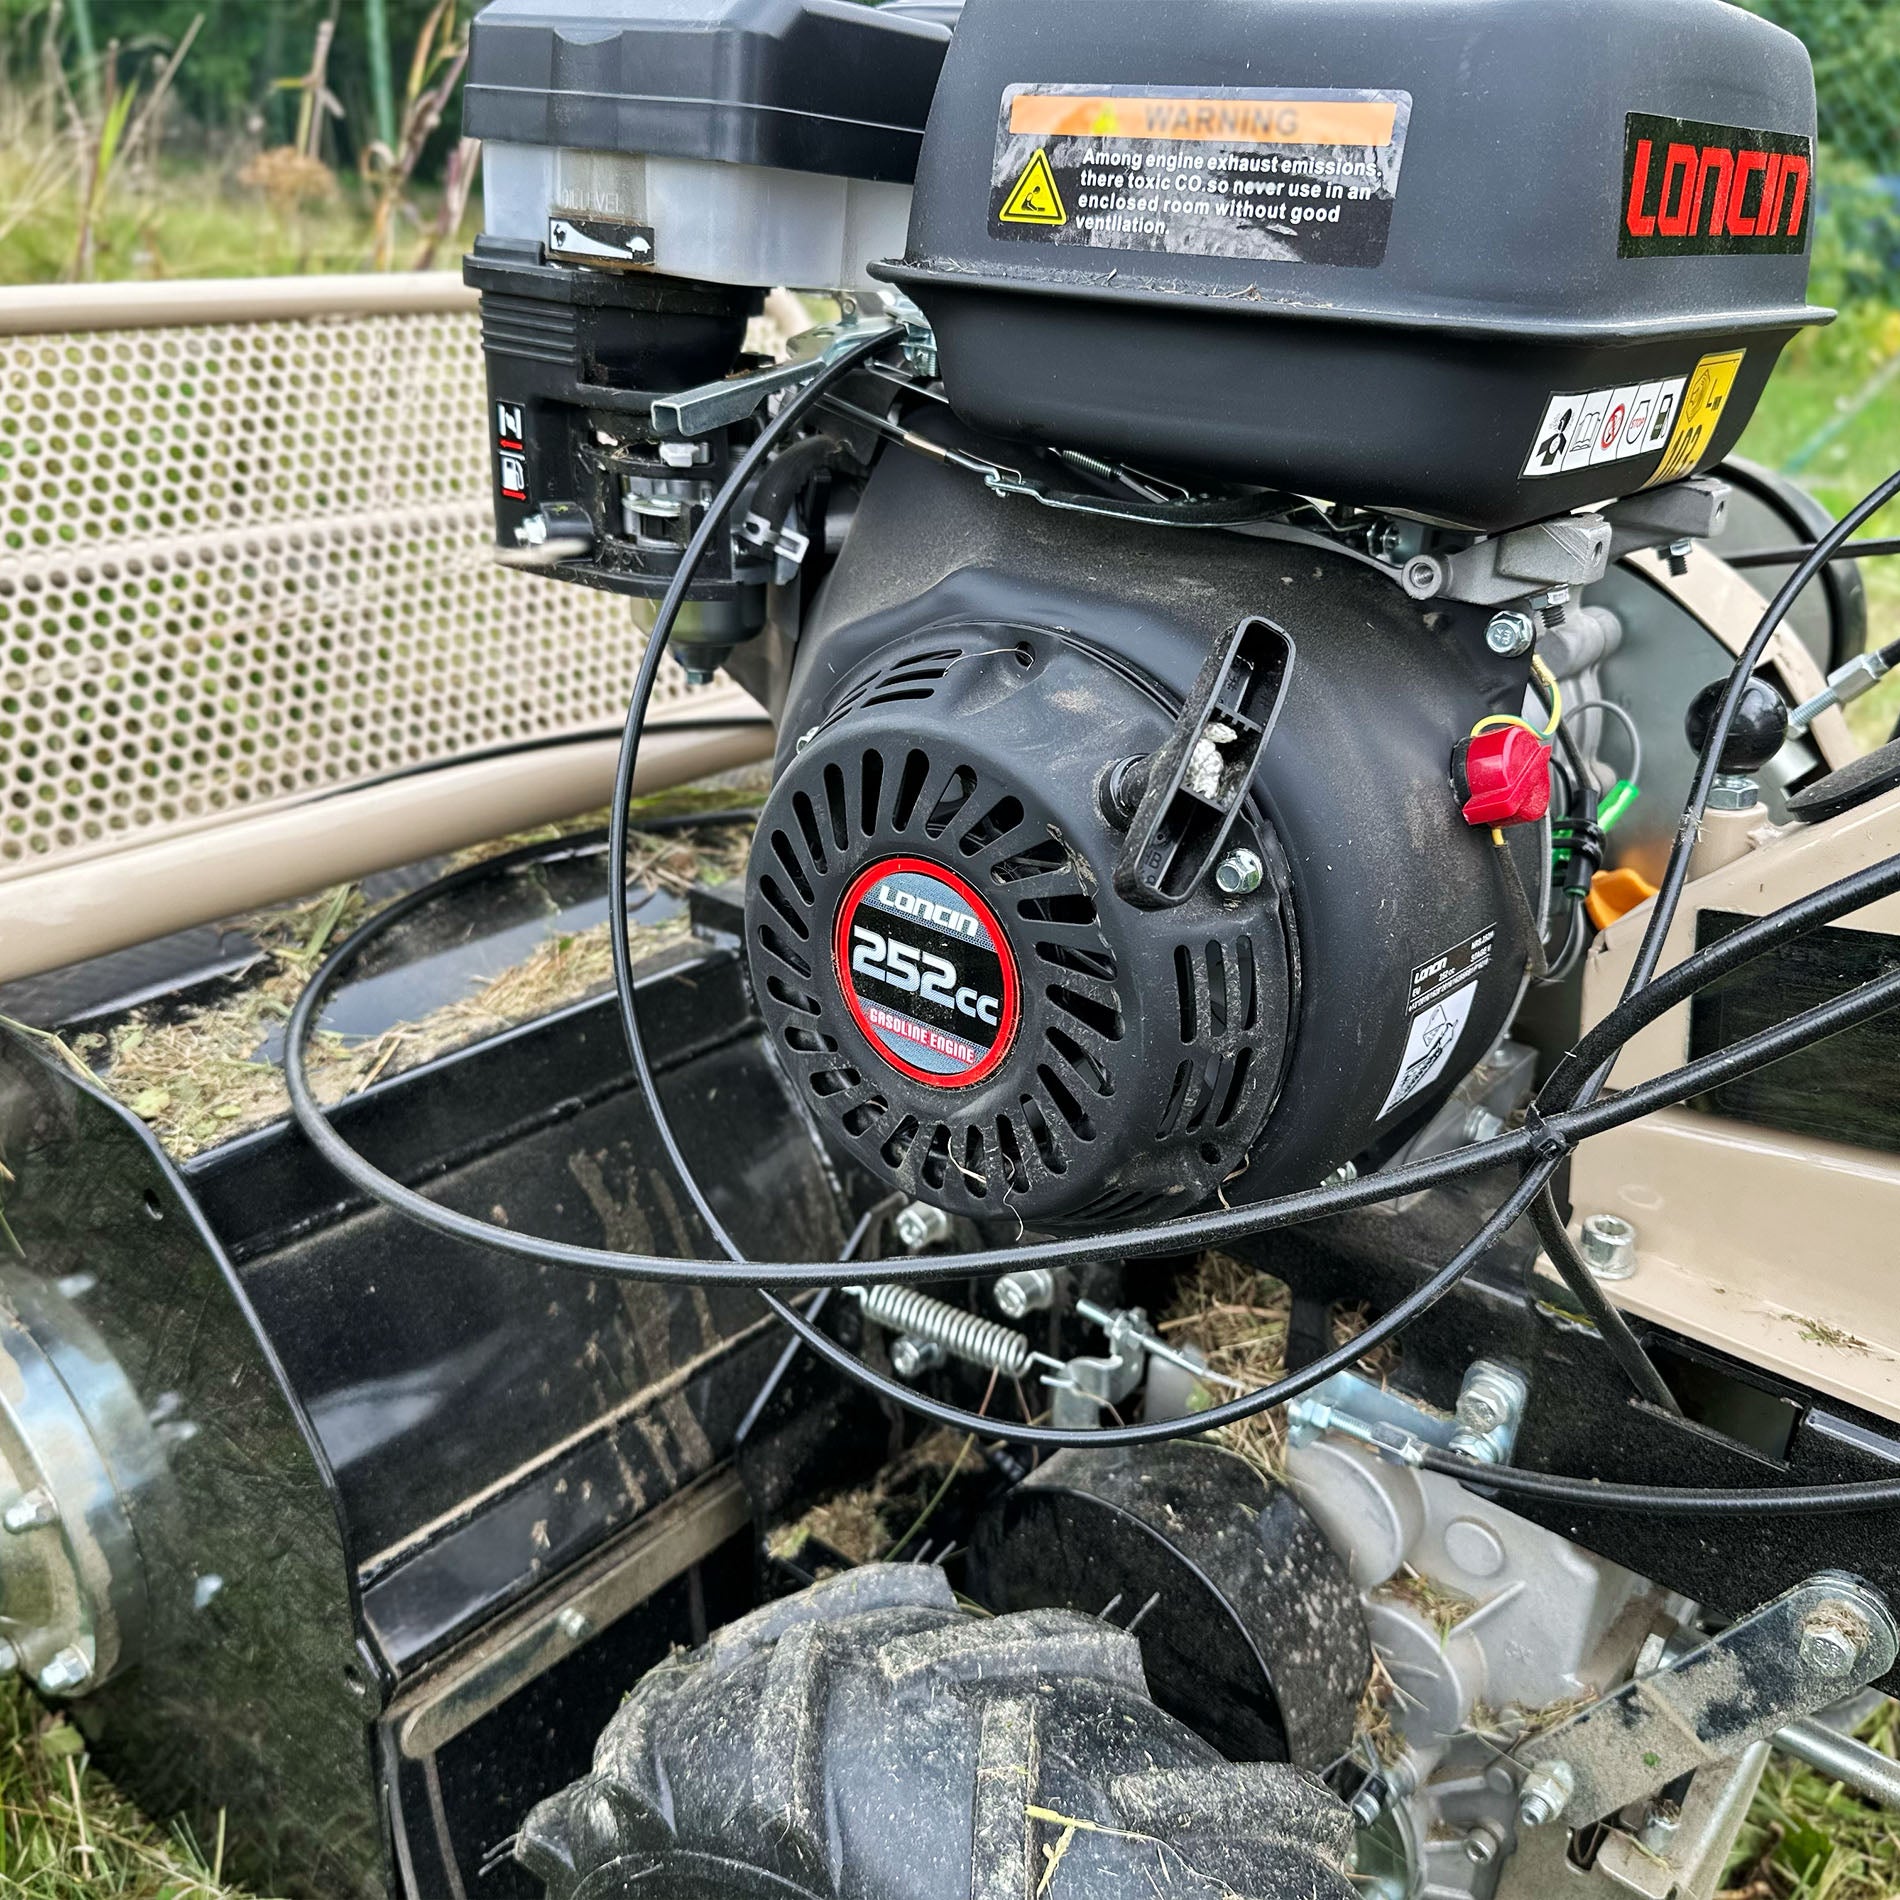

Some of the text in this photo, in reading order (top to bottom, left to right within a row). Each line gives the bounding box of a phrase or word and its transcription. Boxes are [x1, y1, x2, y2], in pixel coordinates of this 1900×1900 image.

[1146, 106, 1298, 135] WARNING
[1083, 148, 1142, 171] Among
[1146, 152, 1204, 172] engine
[1207, 154, 1278, 173] exhaust
[1080, 169, 1124, 188] there
[1128, 173, 1170, 190] toxic
[1233, 181, 1285, 196] never
[1288, 183, 1321, 198] use
[1325, 182, 1343, 199] in
[1347, 186, 1371, 200] an
[1626, 139, 1810, 237] LONCIN
[1078, 192, 1341, 225] enclosed room without good
[1075, 214, 1170, 235] ventilation.
[1629, 417, 1645, 430] STOP
[878, 885, 980, 937] LONCIN
[869, 1008, 976, 1064] GASOLINE ENGINE
